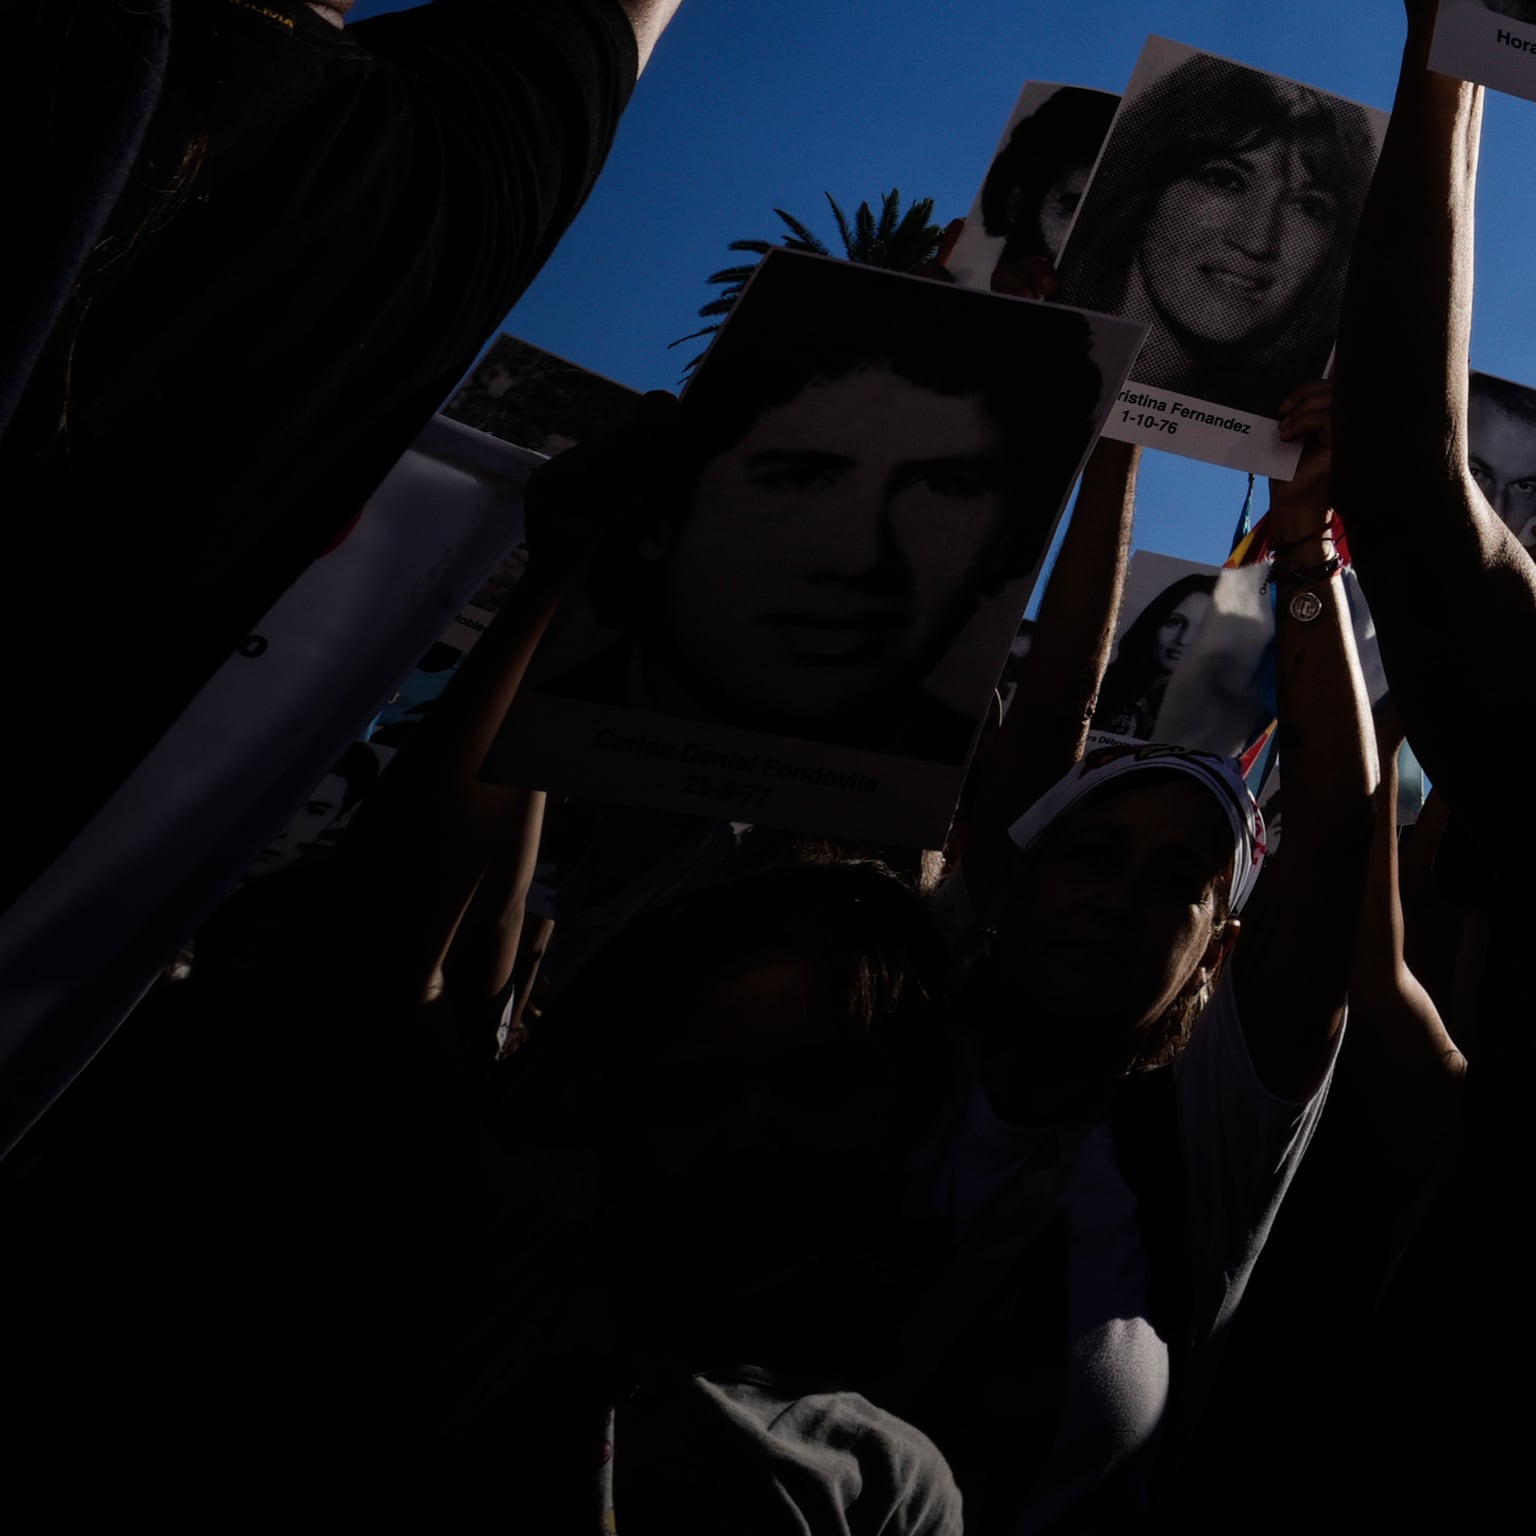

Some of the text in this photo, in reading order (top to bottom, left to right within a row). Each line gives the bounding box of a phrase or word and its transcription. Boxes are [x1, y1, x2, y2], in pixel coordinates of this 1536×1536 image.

[1121, 410, 1179, 435] 1-10-76
[1171, 402, 1252, 435] Fernandez
[592, 727, 674, 761] Carlos
[680, 741, 760, 774] Daniel
